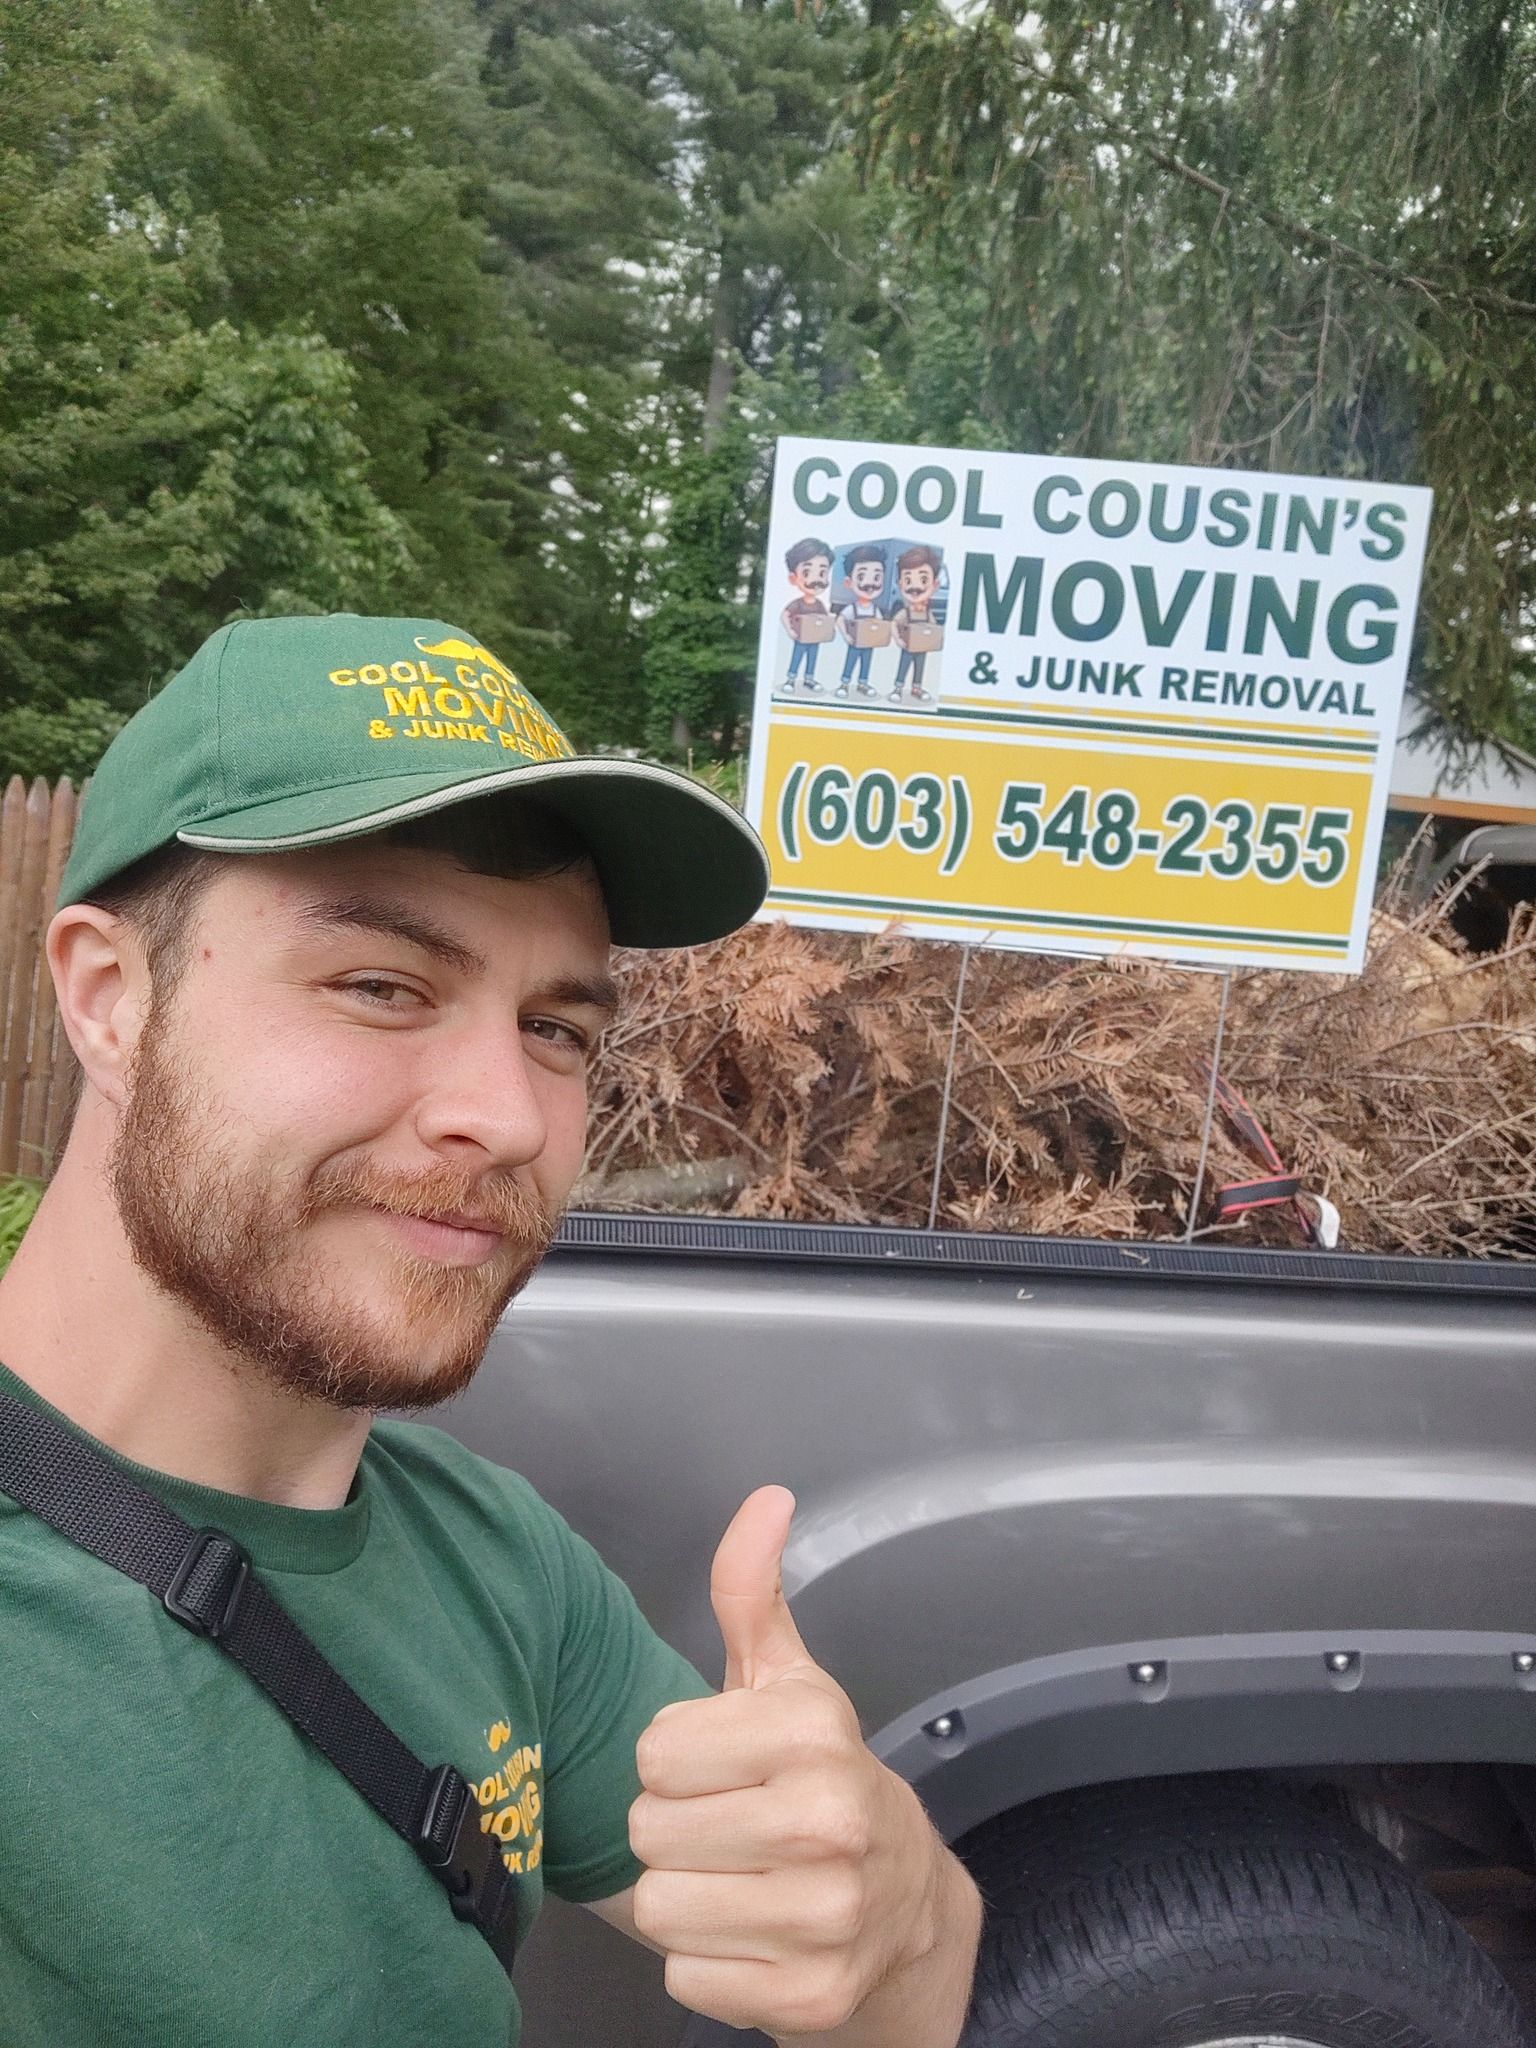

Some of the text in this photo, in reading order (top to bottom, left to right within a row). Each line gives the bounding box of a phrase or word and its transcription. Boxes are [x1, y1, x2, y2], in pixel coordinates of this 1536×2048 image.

[792, 457, 1407, 562] COOL COUSIN'S
[957, 551, 1399, 666] MOVING
[328, 660, 446, 686] COOL
[968, 651, 1376, 718] & JUNK REMOVAL
[368, 718, 494, 744] & JUNK
[779, 763, 1350, 884] (603) 548-2355
